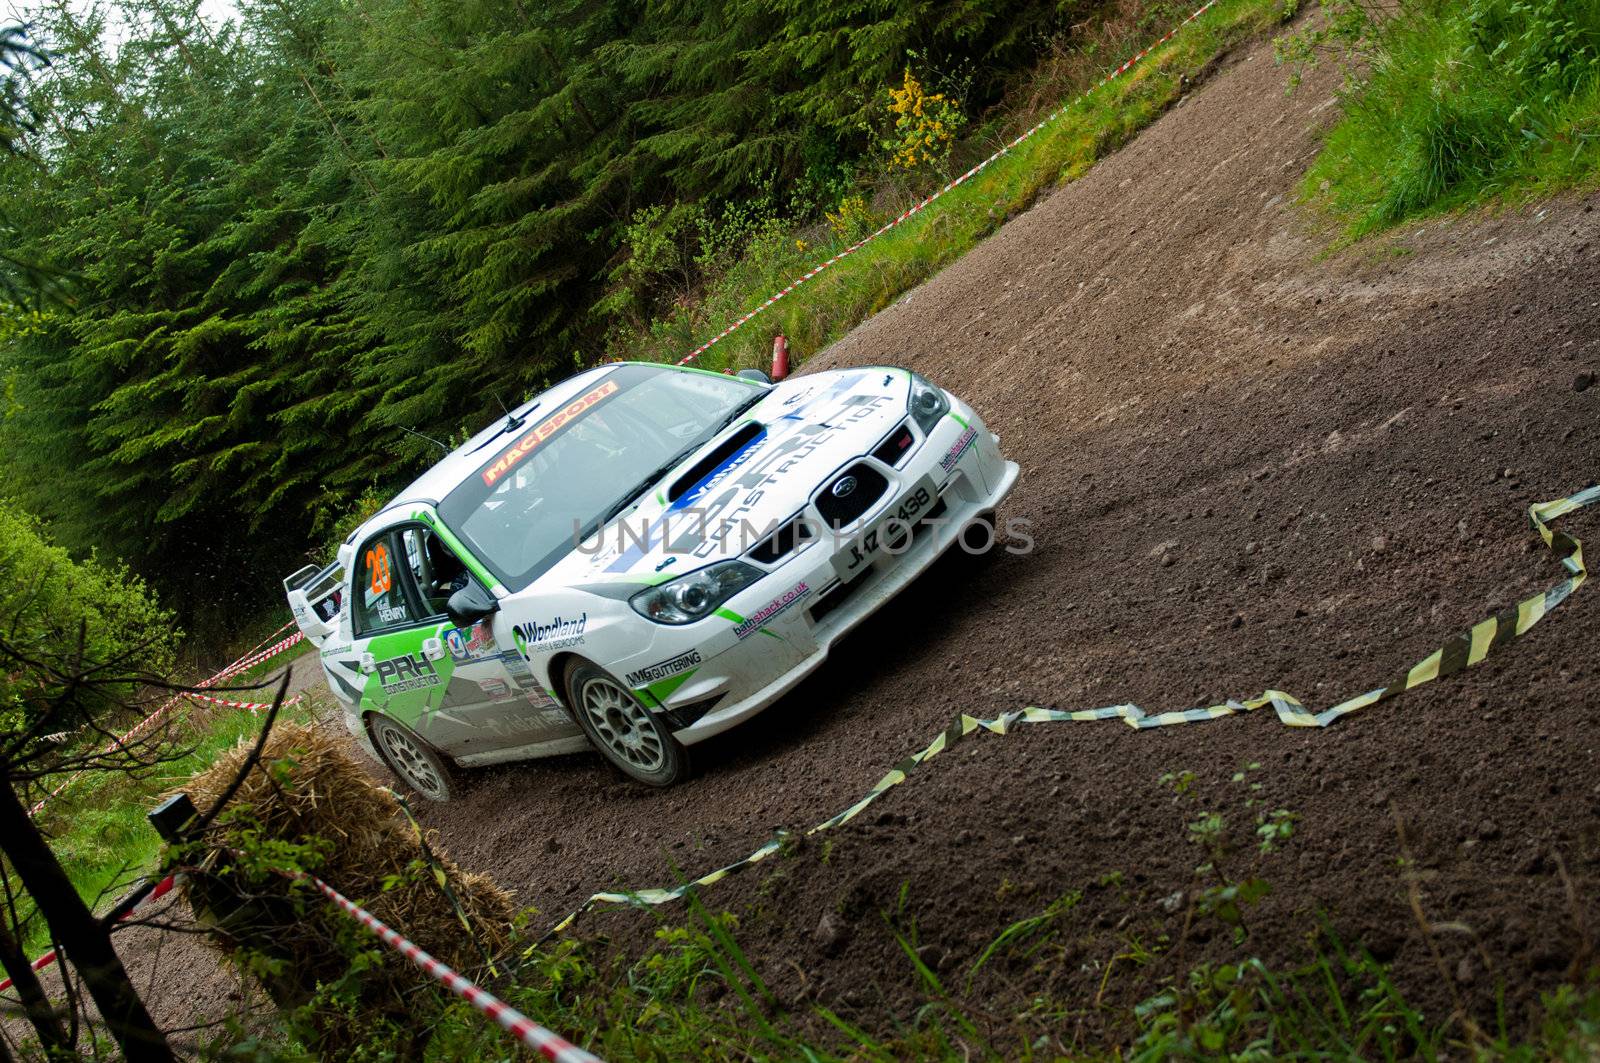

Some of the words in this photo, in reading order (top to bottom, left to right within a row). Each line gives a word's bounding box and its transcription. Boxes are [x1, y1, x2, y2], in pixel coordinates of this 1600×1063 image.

[539, 384, 611, 437] SPORT
[886, 487, 930, 535] 2438
[366, 544, 391, 594] 20
[379, 605, 406, 622] HENRY
[523, 612, 587, 643] Woodland
[733, 581, 809, 635] bathshack.co.uk
[376, 652, 437, 686] PRH
[651, 651, 702, 679] GUTTERING
